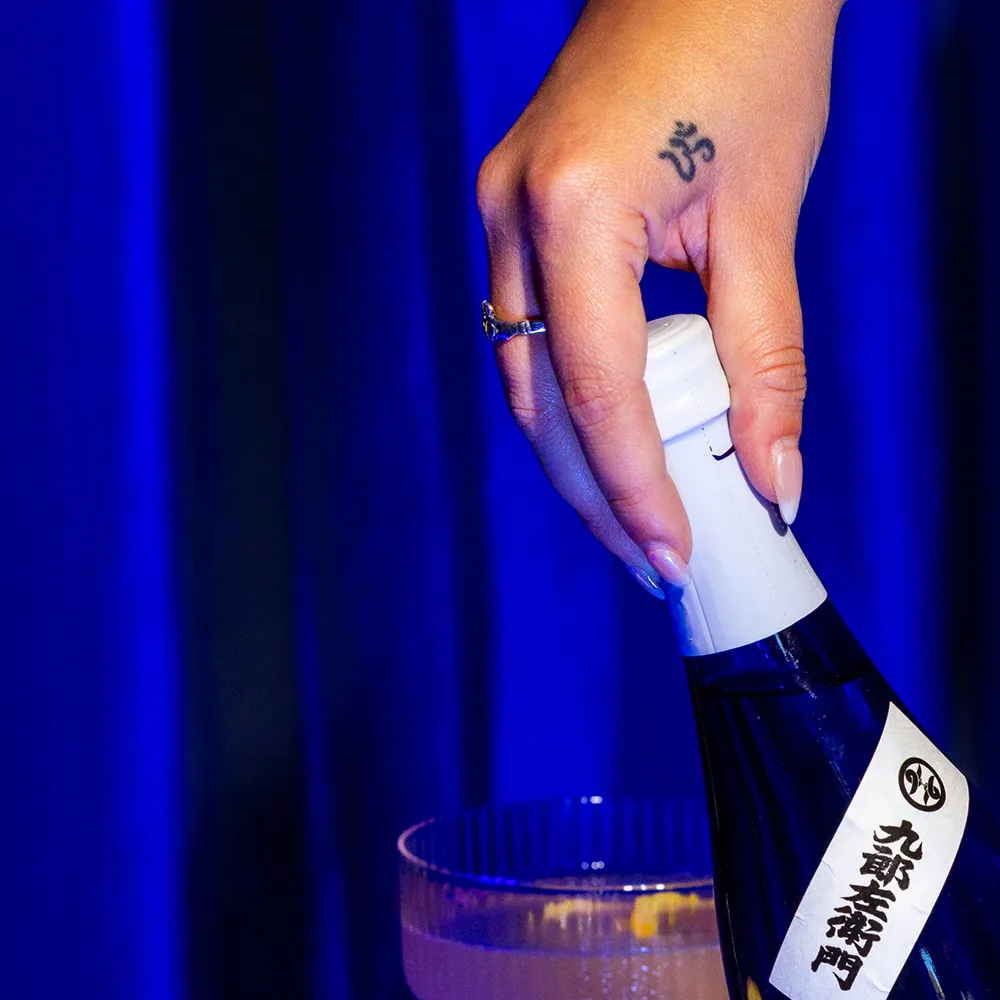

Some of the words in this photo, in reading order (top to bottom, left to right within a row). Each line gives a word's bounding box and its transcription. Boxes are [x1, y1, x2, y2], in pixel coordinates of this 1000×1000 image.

[811, 820, 923, 991] 九郎左衛門
